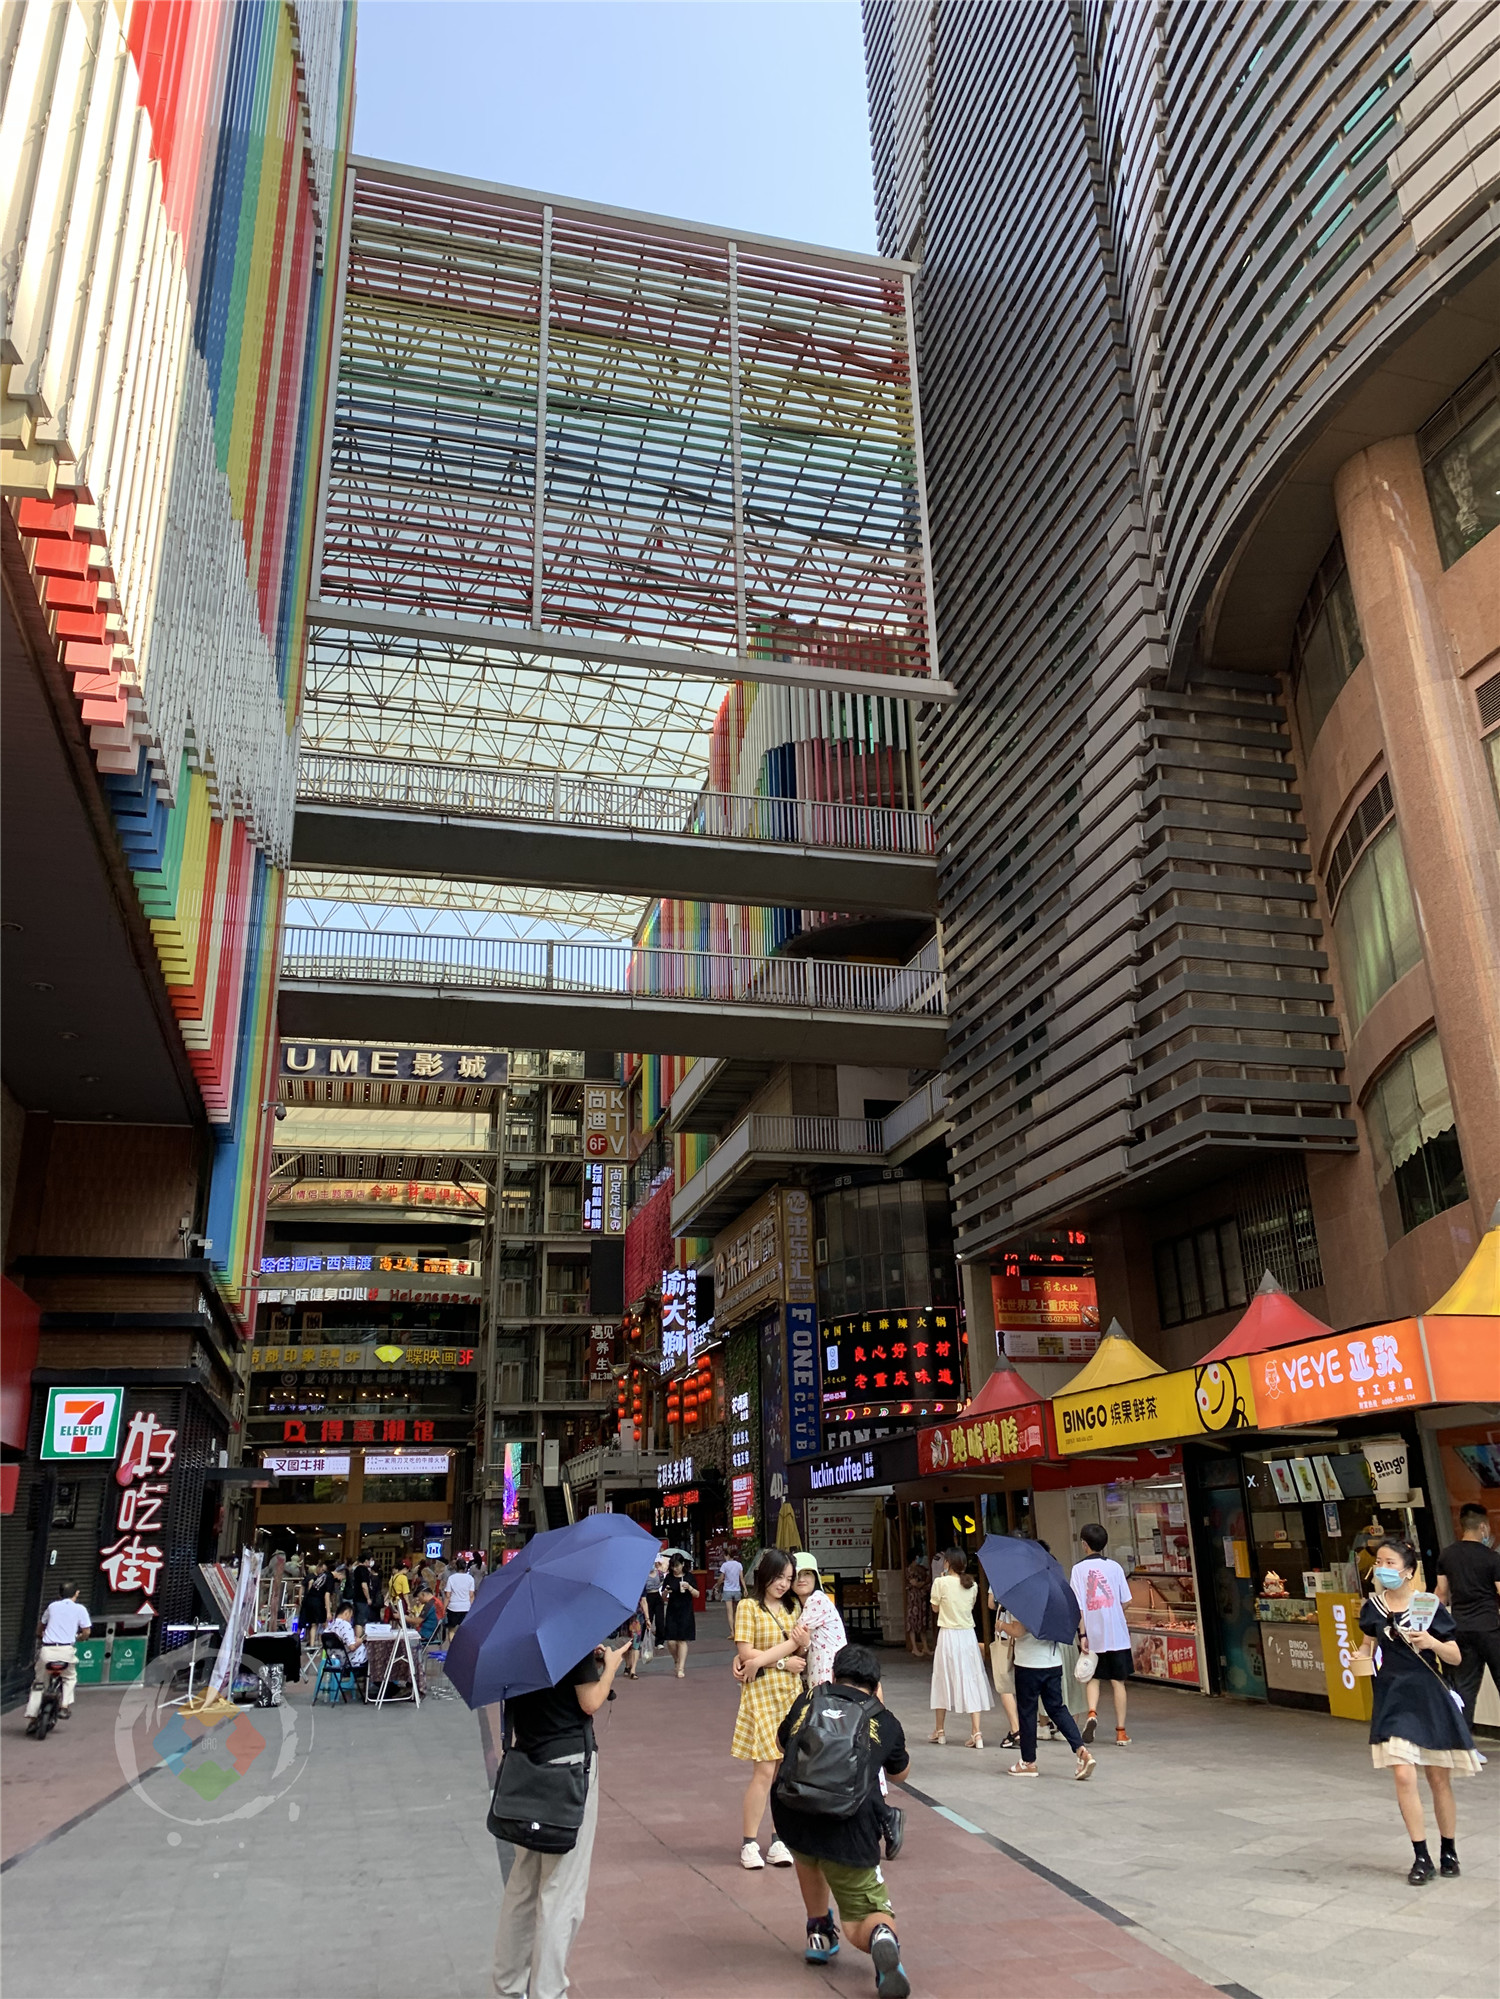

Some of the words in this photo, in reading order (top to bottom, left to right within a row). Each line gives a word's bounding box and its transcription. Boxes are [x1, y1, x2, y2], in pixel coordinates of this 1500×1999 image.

[587, 1090, 607, 1130] 尚迪
[610, 1091, 624, 1155] KTV
[589, 1137, 606, 1152] 6F
[296, 1189, 365, 1200] 情侣主题酒店
[996, 1299, 1080, 1312] 让世界爱上重庆味
[591, 1325, 614, 1339] 遇见
[823, 1316, 947, 1339] 中国十佳麻辣火锅
[345, 1351, 361, 1363] 3F
[405, 1348, 457, 1365] 蝶映画
[458, 1349, 474, 1366] 3F
[791, 1308, 815, 1386] FONE
[854, 1340, 951, 1363] 良心好食材
[319, 1359, 340, 1368] SPA
[1282, 1348, 1344, 1393] YEYE
[854, 1368, 954, 1389] 老重庆味道
[794, 1392, 808, 1450] CLUB
[1062, 1404, 1108, 1433] BINGO
[1110, 1396, 1158, 1426] 缤果鲜茶
[64, 1400, 105, 1453] 7
[321, 1420, 435, 1442] 得意潮馆
[951, 1415, 1019, 1464] 绝味鸭脖
[810, 1461, 834, 1489] luckin
[835, 1456, 862, 1485] coffee
[1373, 1456, 1405, 1474] Bingo
[100, 1411, 177, 1595] 好吃街
[1288, 1640, 1309, 1650] BINGO
[1289, 1649, 1314, 1659] DRINKS
[1332, 1604, 1356, 1689] BINGO
